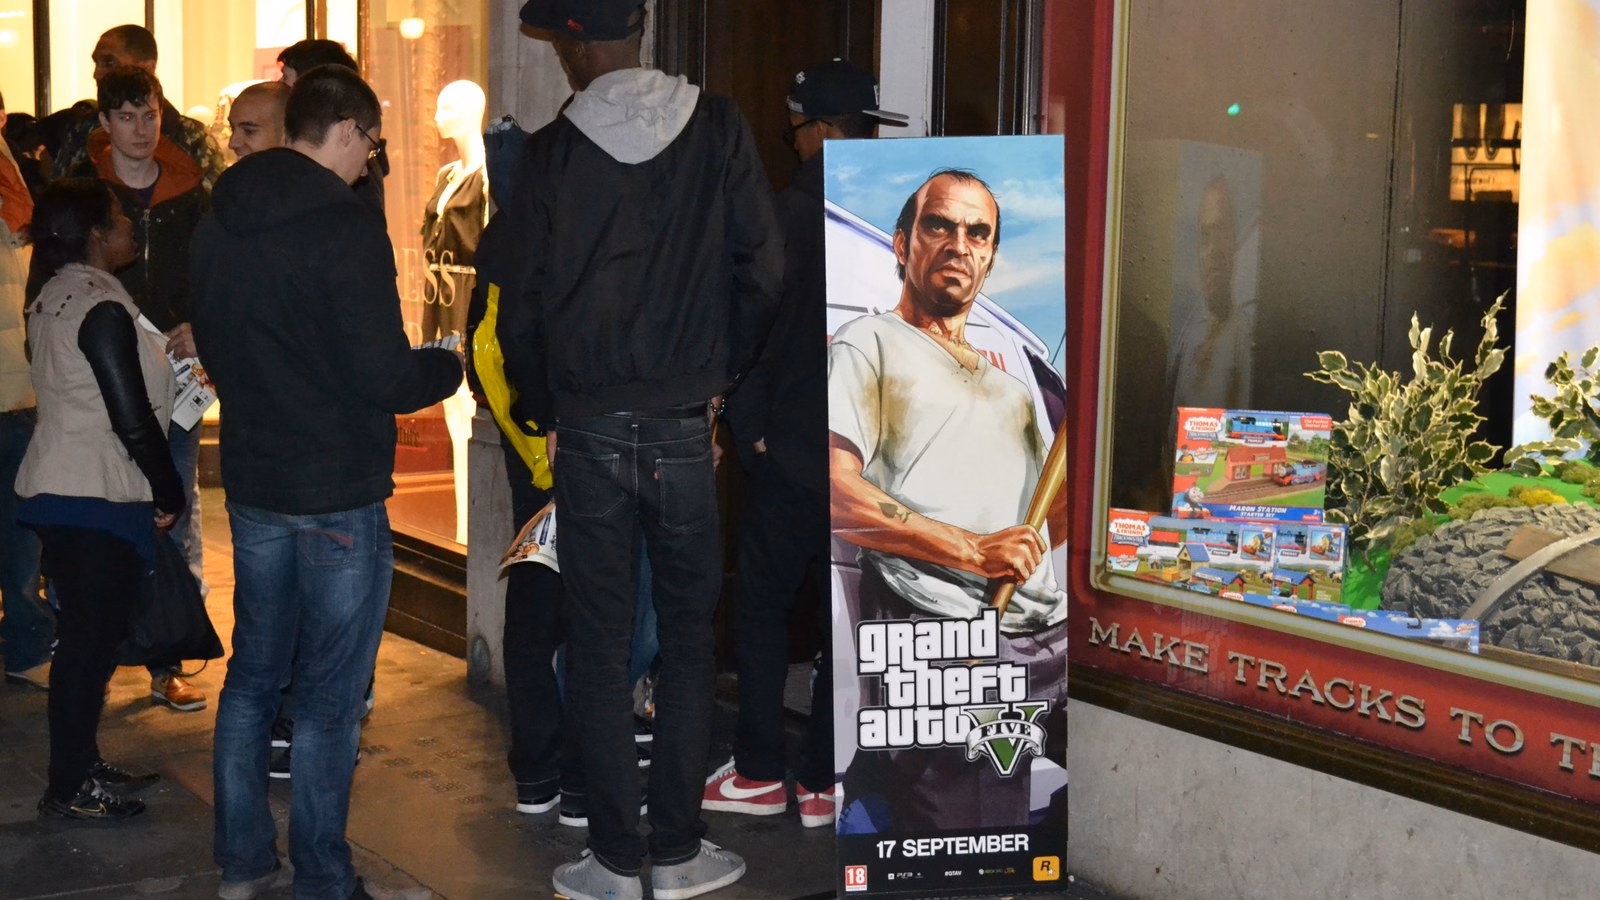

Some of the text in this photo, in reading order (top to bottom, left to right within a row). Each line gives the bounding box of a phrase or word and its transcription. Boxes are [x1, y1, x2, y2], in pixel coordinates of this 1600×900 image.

[393, 247, 456, 307] ESS
[1115, 522, 1146, 531] THOMAS
[1228, 505, 1287, 514] MARON STATION
[859, 608, 997, 674] grand
[884, 659, 1028, 708] theft
[1088, 617, 1208, 673] MAKE
[1228, 650, 1426, 730] TRACKS
[1449, 706, 1526, 755] TO
[859, 706, 970, 748] auto
[876, 834, 1029, 858] 17 SEPTEMBER
[847, 868, 865, 885] 18
